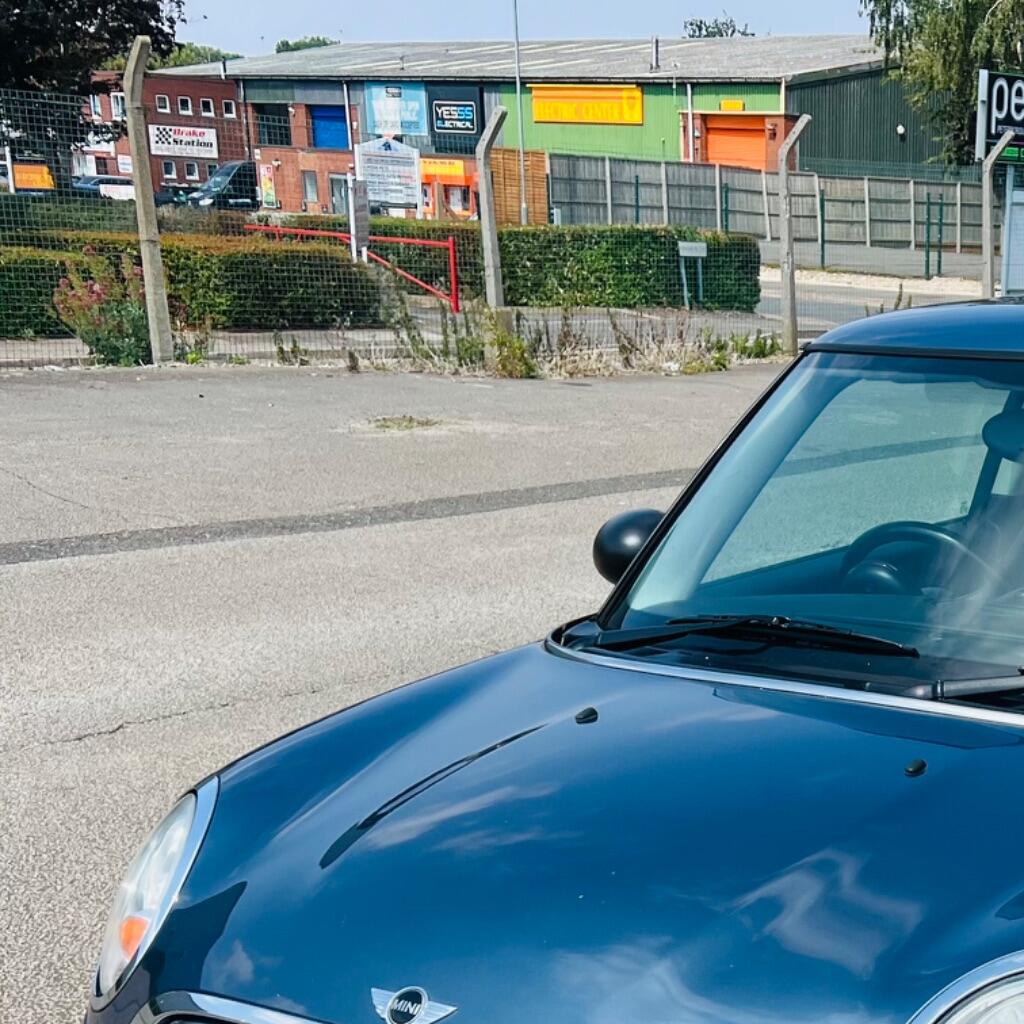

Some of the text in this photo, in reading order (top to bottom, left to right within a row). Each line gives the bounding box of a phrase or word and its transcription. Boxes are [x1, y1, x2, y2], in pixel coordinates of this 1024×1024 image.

[436, 106, 473, 119] YESSS
[173, 128, 205, 137] Brake
[173, 138, 213, 148] Station
[392, 999, 421, 1015] MINI
